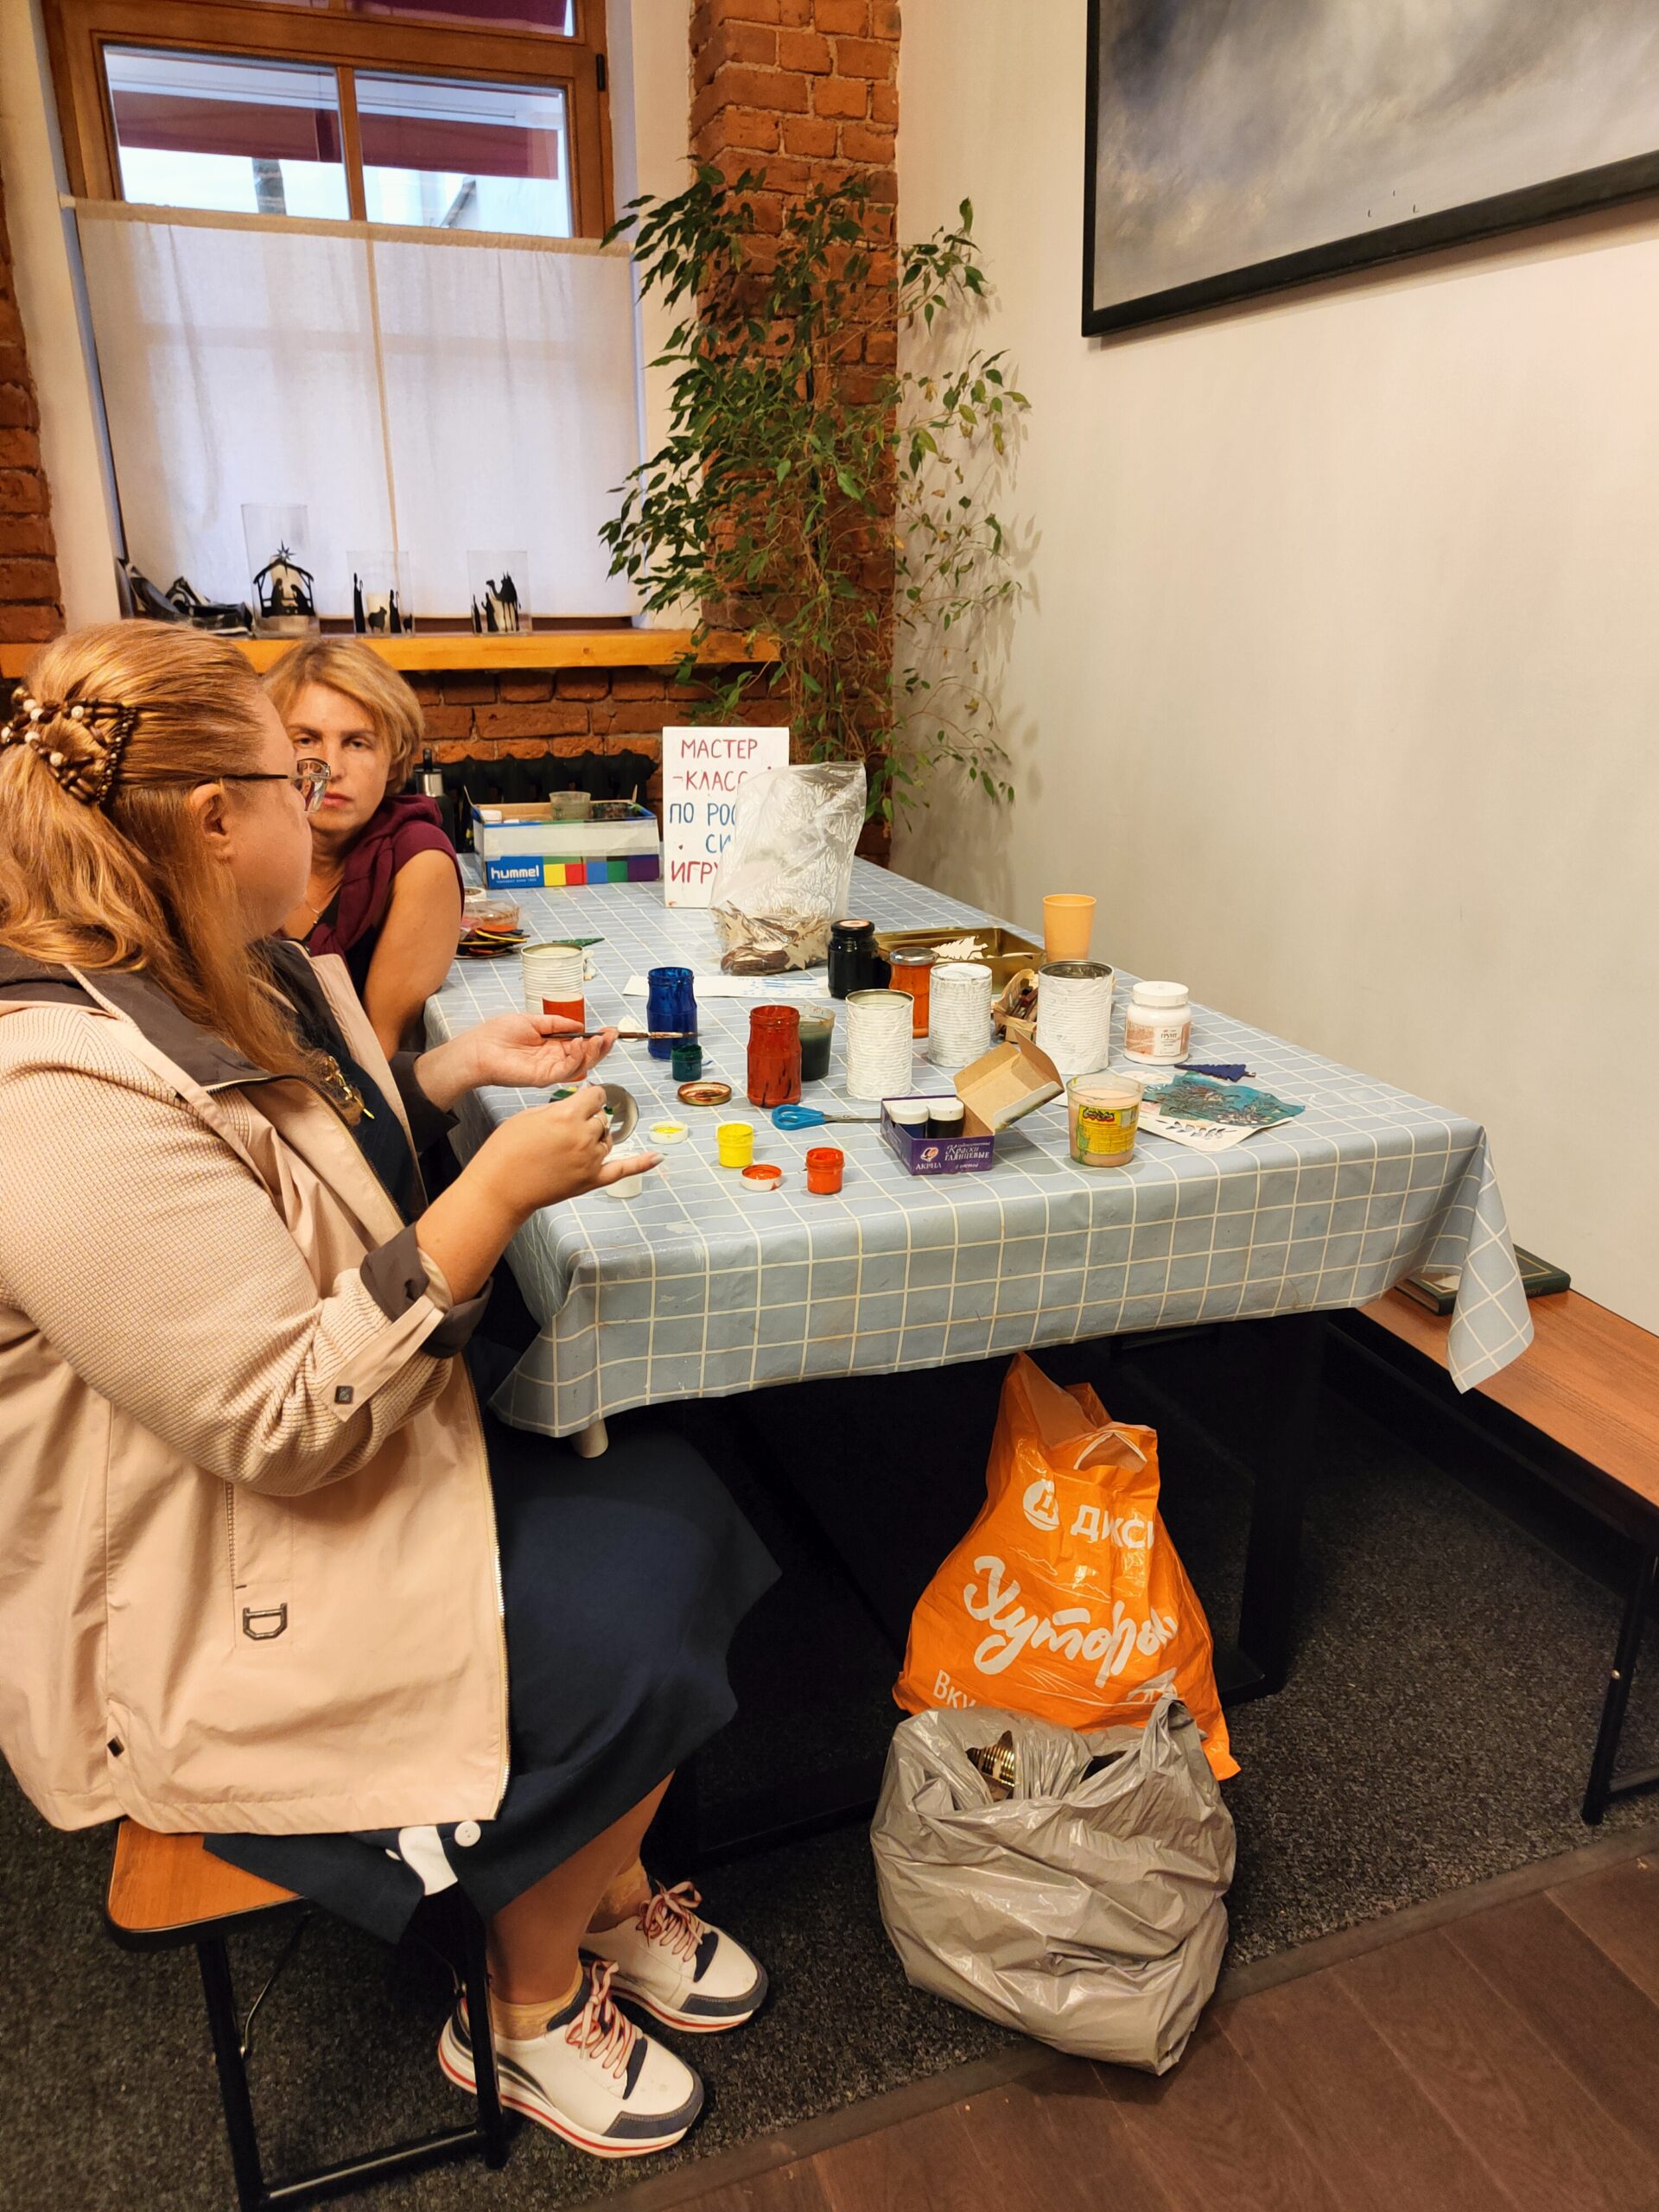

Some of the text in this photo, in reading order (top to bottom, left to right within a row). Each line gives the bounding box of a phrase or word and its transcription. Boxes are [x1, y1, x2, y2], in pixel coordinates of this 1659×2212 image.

[681, 738, 758, 760] МАСТЕР
[669, 802, 736, 827] ПО РОС
[490, 865, 540, 880] hummel
[671, 861, 719, 885] ИГР
[932, 1669, 977, 1709] Вку
